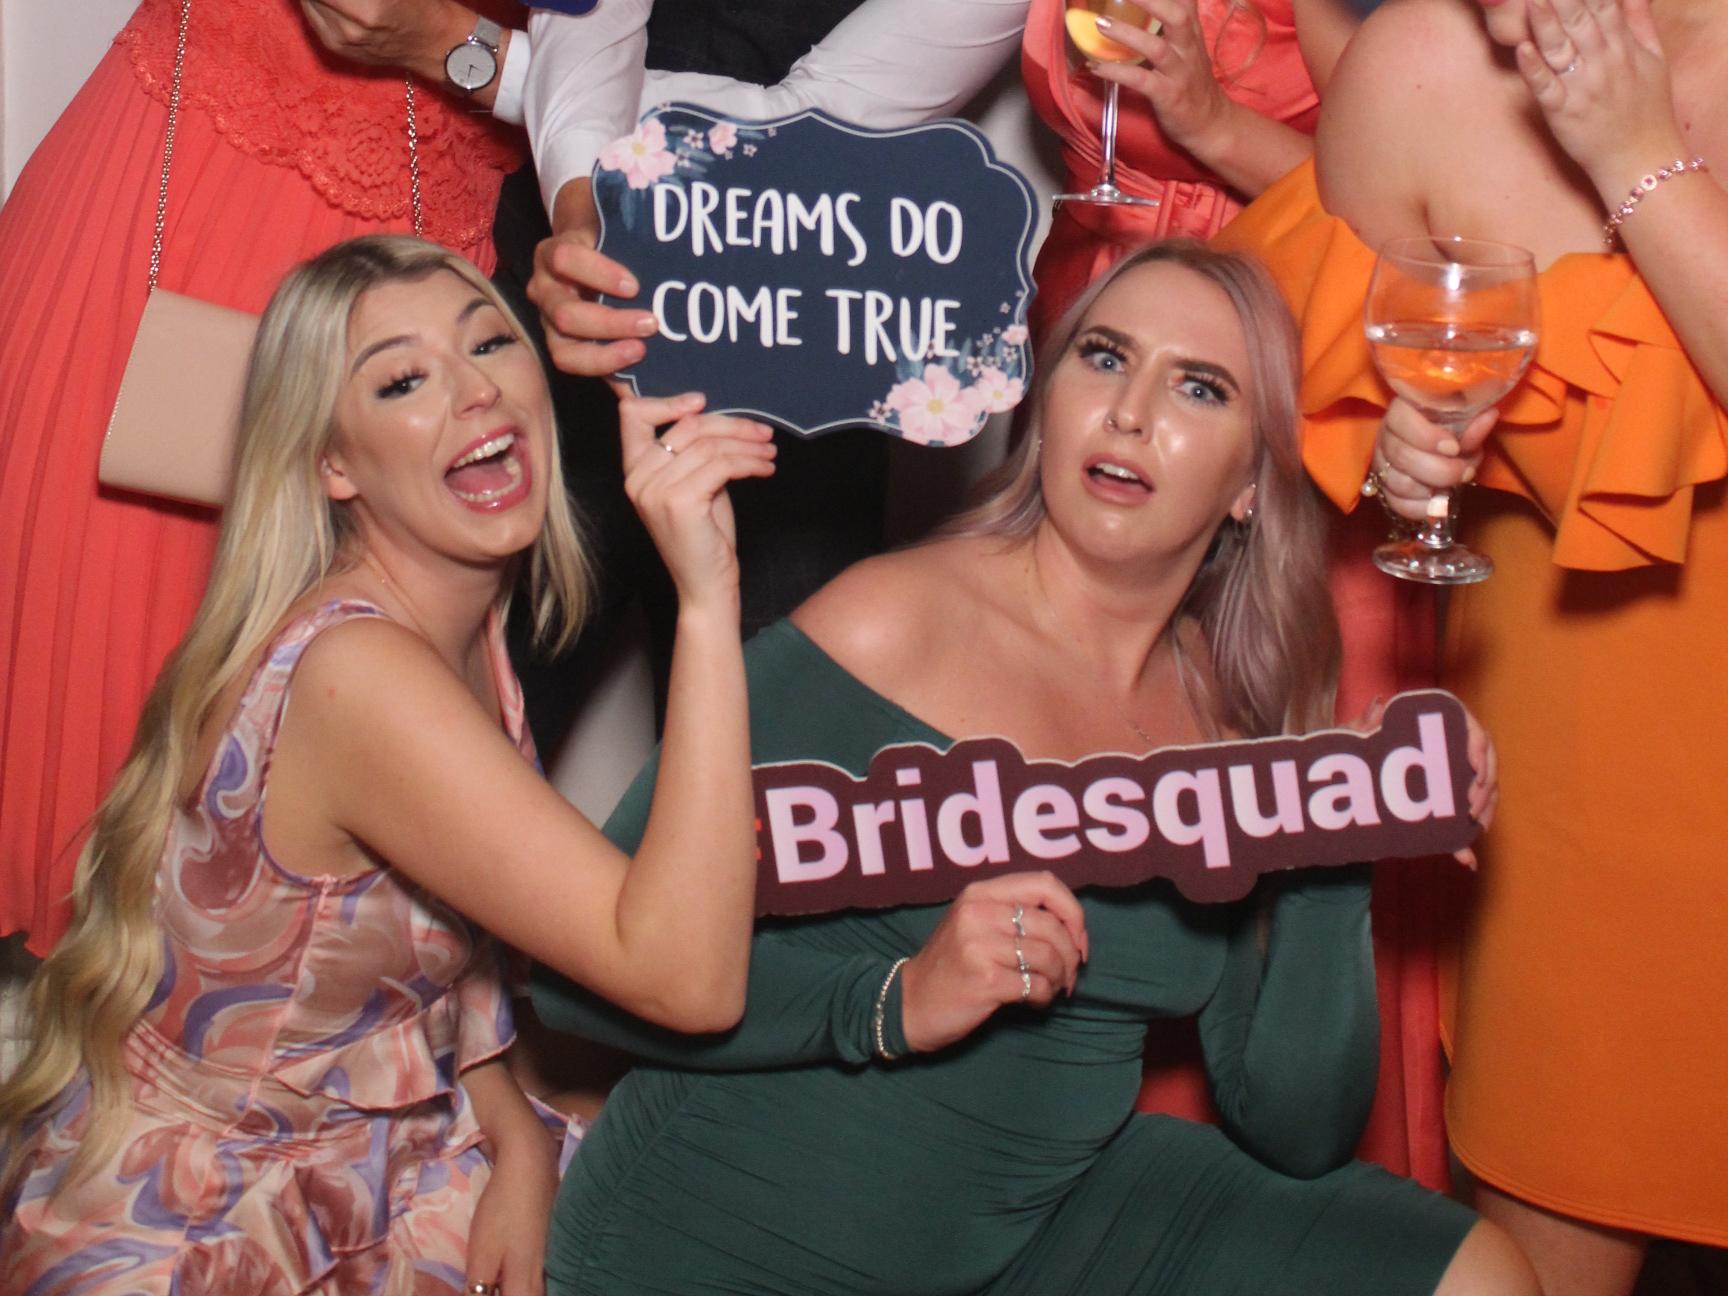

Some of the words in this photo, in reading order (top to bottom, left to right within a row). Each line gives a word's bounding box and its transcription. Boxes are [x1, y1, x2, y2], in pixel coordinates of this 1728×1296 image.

[653, 182, 867, 266] DREAMS
[890, 197, 963, 264] DO
[652, 280, 802, 347] COME
[825, 289, 961, 365] TRUE
[755, 713, 1456, 884] Bridesquad
